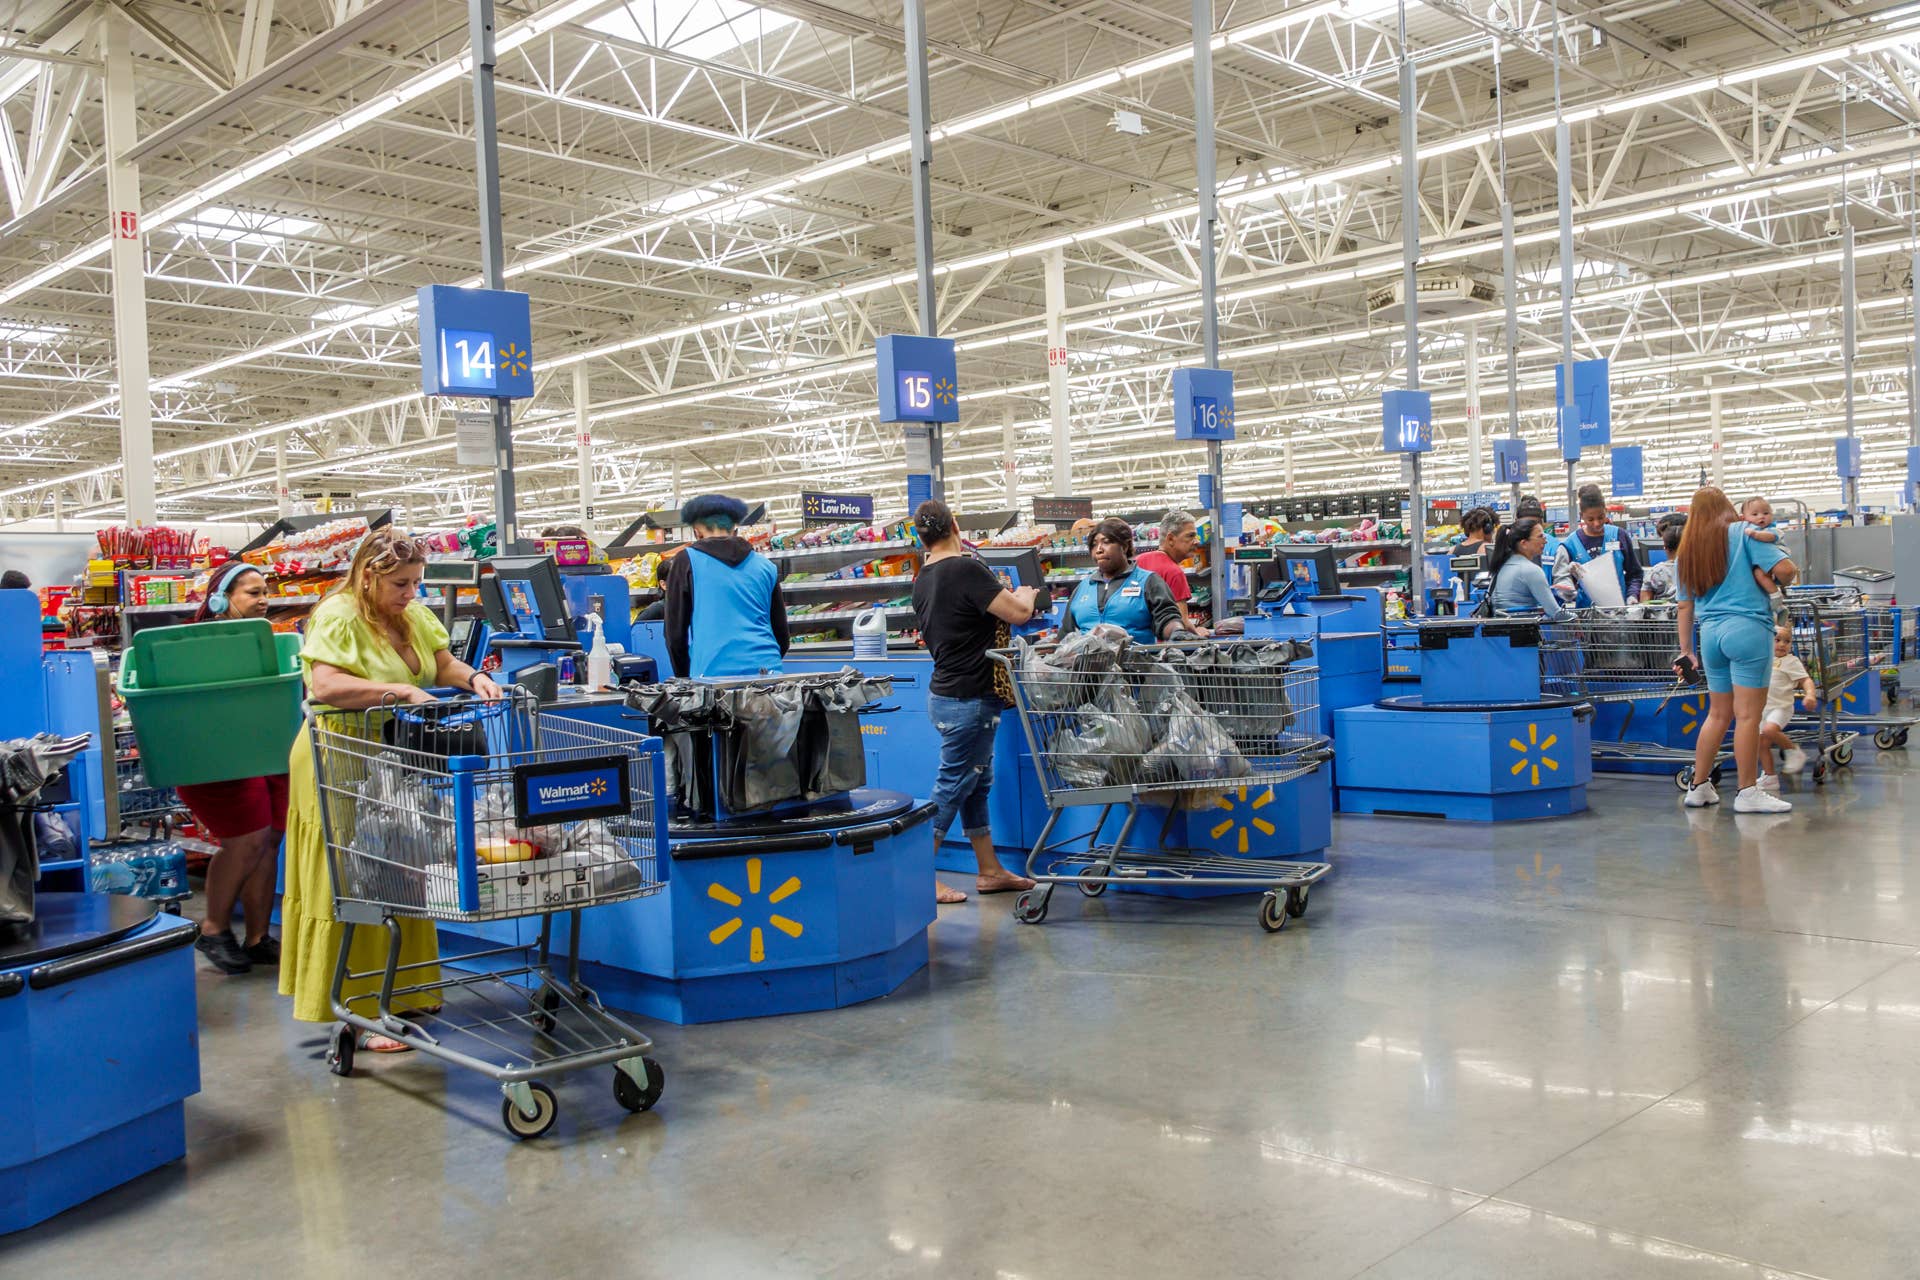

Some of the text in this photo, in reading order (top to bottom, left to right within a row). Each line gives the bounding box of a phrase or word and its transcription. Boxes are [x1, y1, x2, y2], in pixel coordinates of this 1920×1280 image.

[455, 339, 495, 379] 14
[905, 376, 930, 409] 15
[1200, 403, 1217, 429] 16
[1406, 420, 1419, 442] 17
[1509, 460, 1518, 476] 19
[821, 503, 860, 515] Low Price
[860, 724, 887, 735] etter.
[539, 782, 590, 799] Walmart
